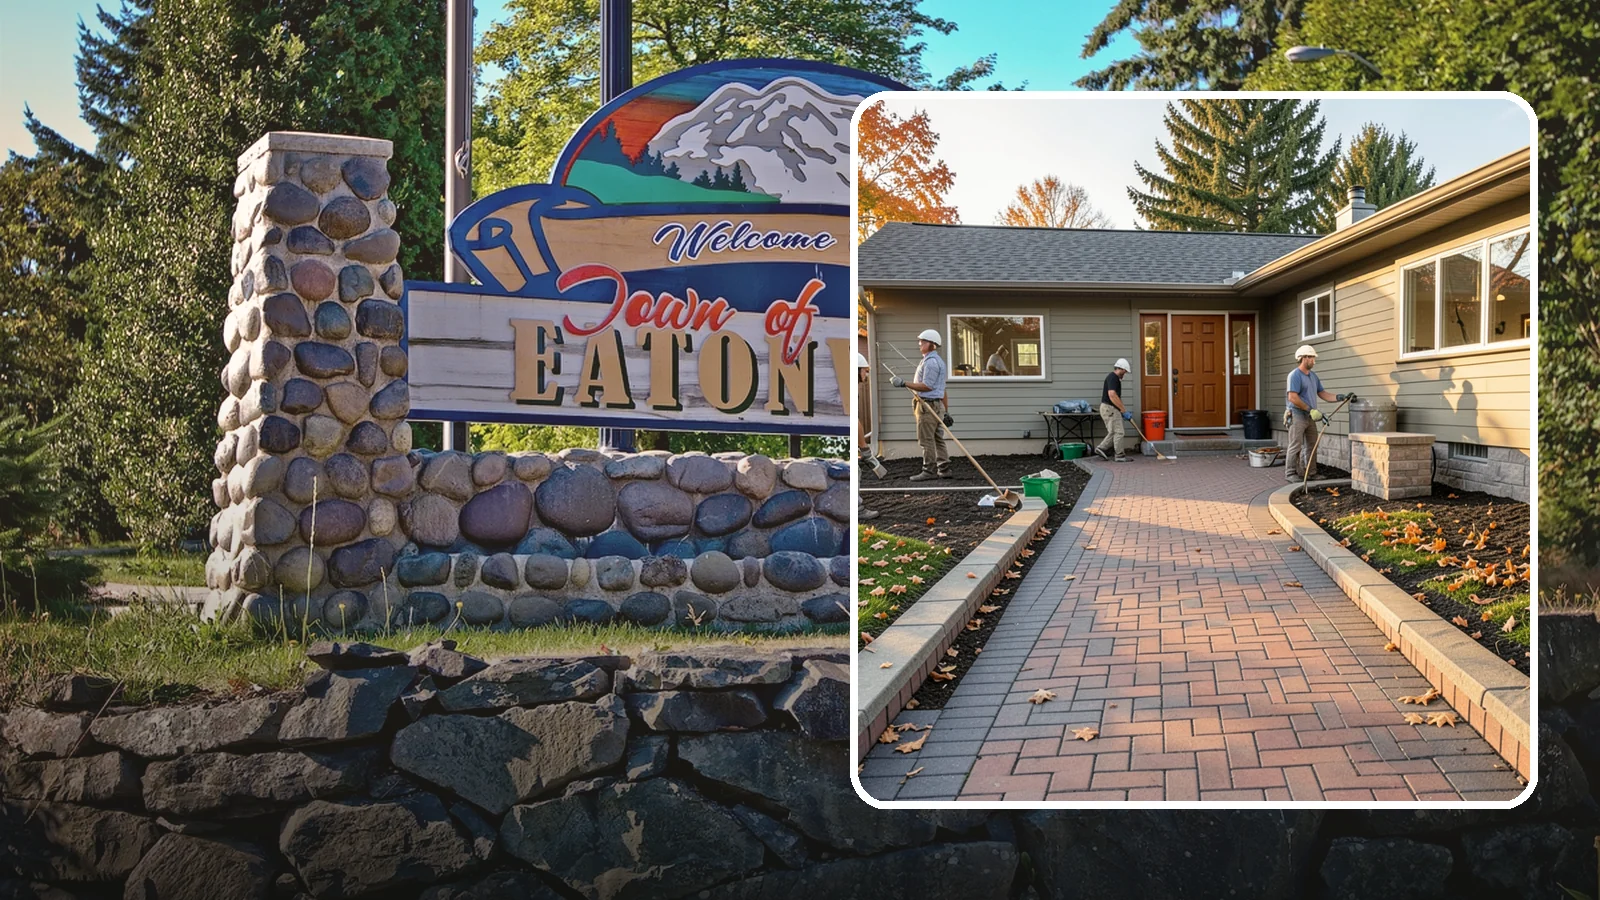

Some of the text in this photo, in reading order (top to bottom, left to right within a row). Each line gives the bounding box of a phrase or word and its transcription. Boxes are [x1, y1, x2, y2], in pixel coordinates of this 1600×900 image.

[654, 221, 836, 263] Welcome
[557, 264, 825, 364] Town of
